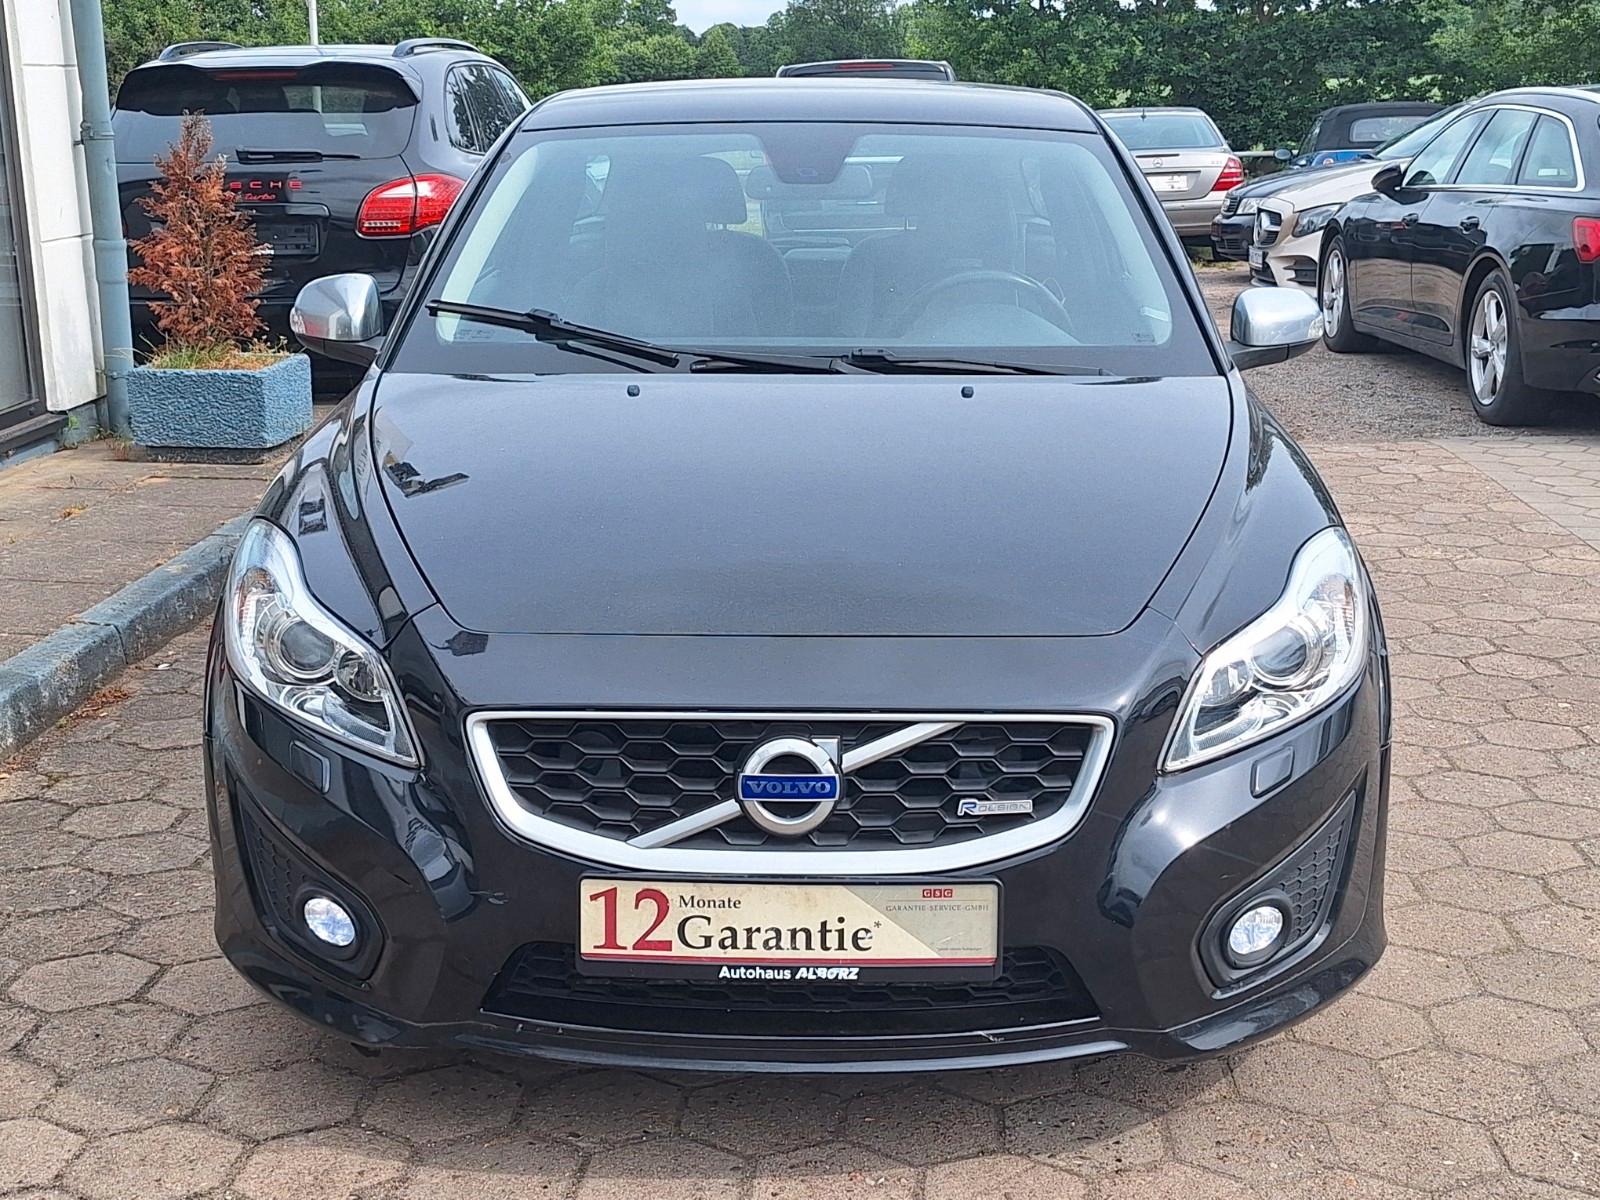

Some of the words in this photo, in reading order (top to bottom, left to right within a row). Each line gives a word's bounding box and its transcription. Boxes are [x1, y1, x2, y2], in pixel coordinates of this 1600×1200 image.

[746, 780, 831, 794] VOLVO
[922, 888, 953, 898] GSG
[589, 886, 673, 952] 12
[679, 895, 741, 909] Monate
[718, 965, 791, 980] Autohaus
